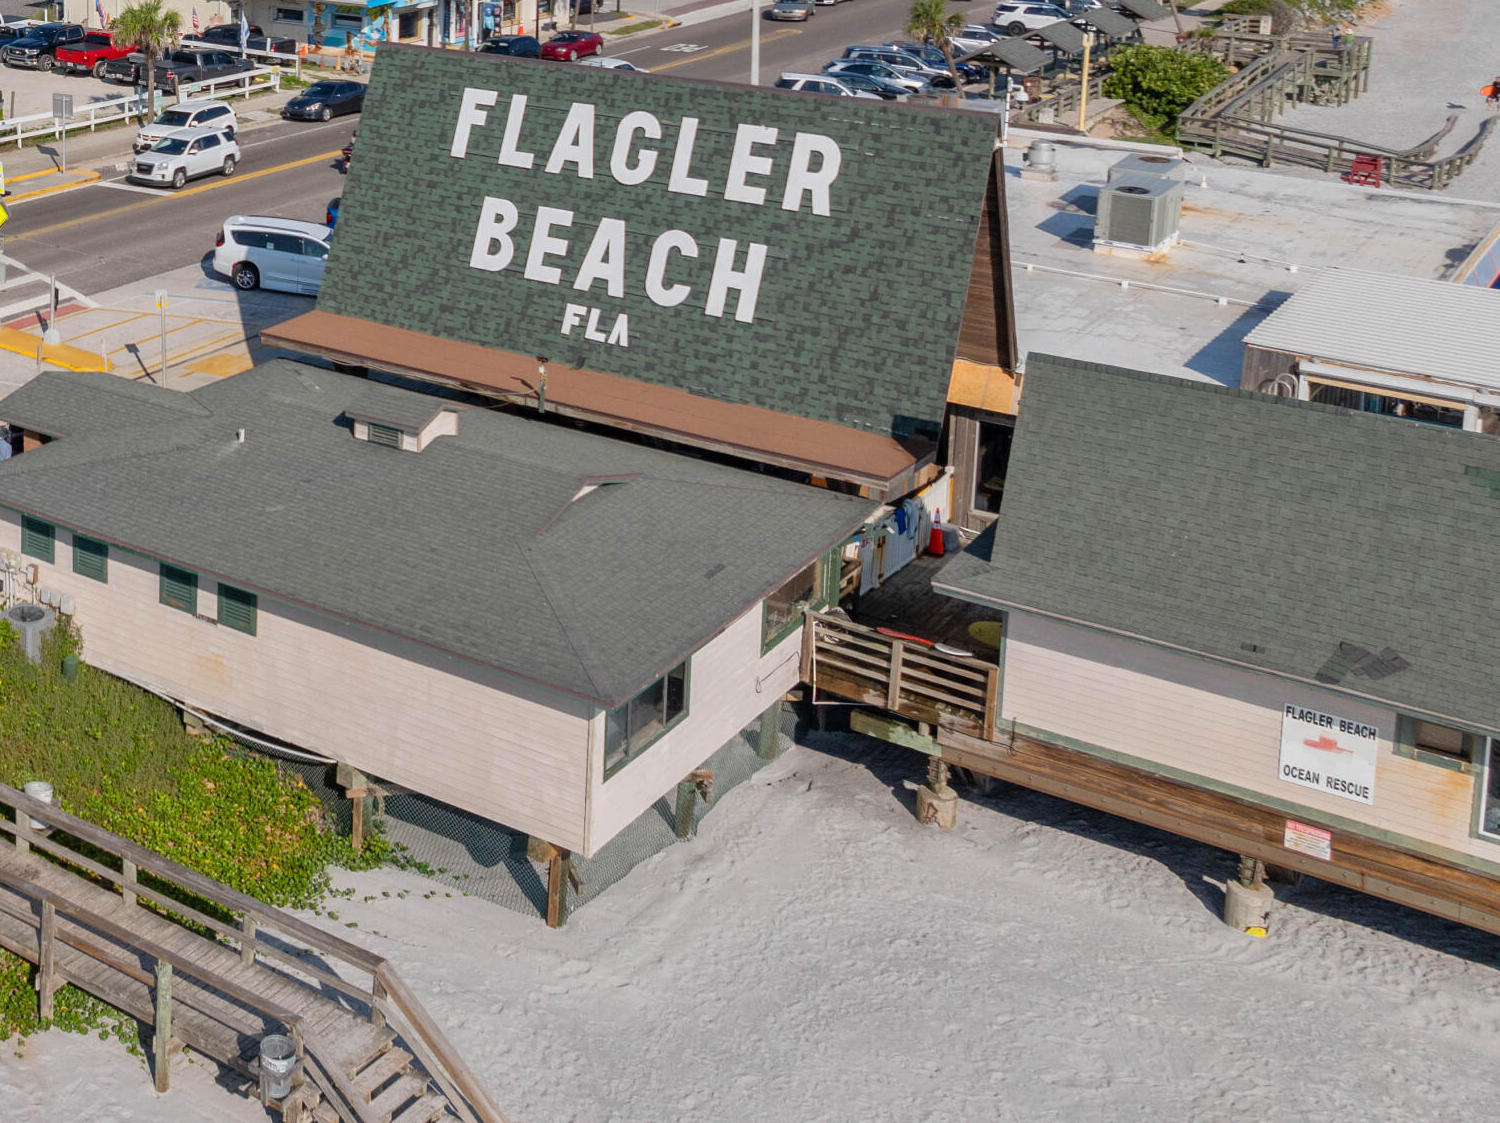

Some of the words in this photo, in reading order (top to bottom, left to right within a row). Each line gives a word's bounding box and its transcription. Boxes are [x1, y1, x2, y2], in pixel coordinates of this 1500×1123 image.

[450, 87, 842, 217] FLAGLER
[470, 195, 768, 324] BEACH
[560, 302, 629, 348] FLA
[1285, 705, 1333, 729] FLAGLER
[1339, 720, 1377, 740] BEACH
[1283, 764, 1320, 785] OCEAN
[1325, 776, 1369, 799] RESCUE
